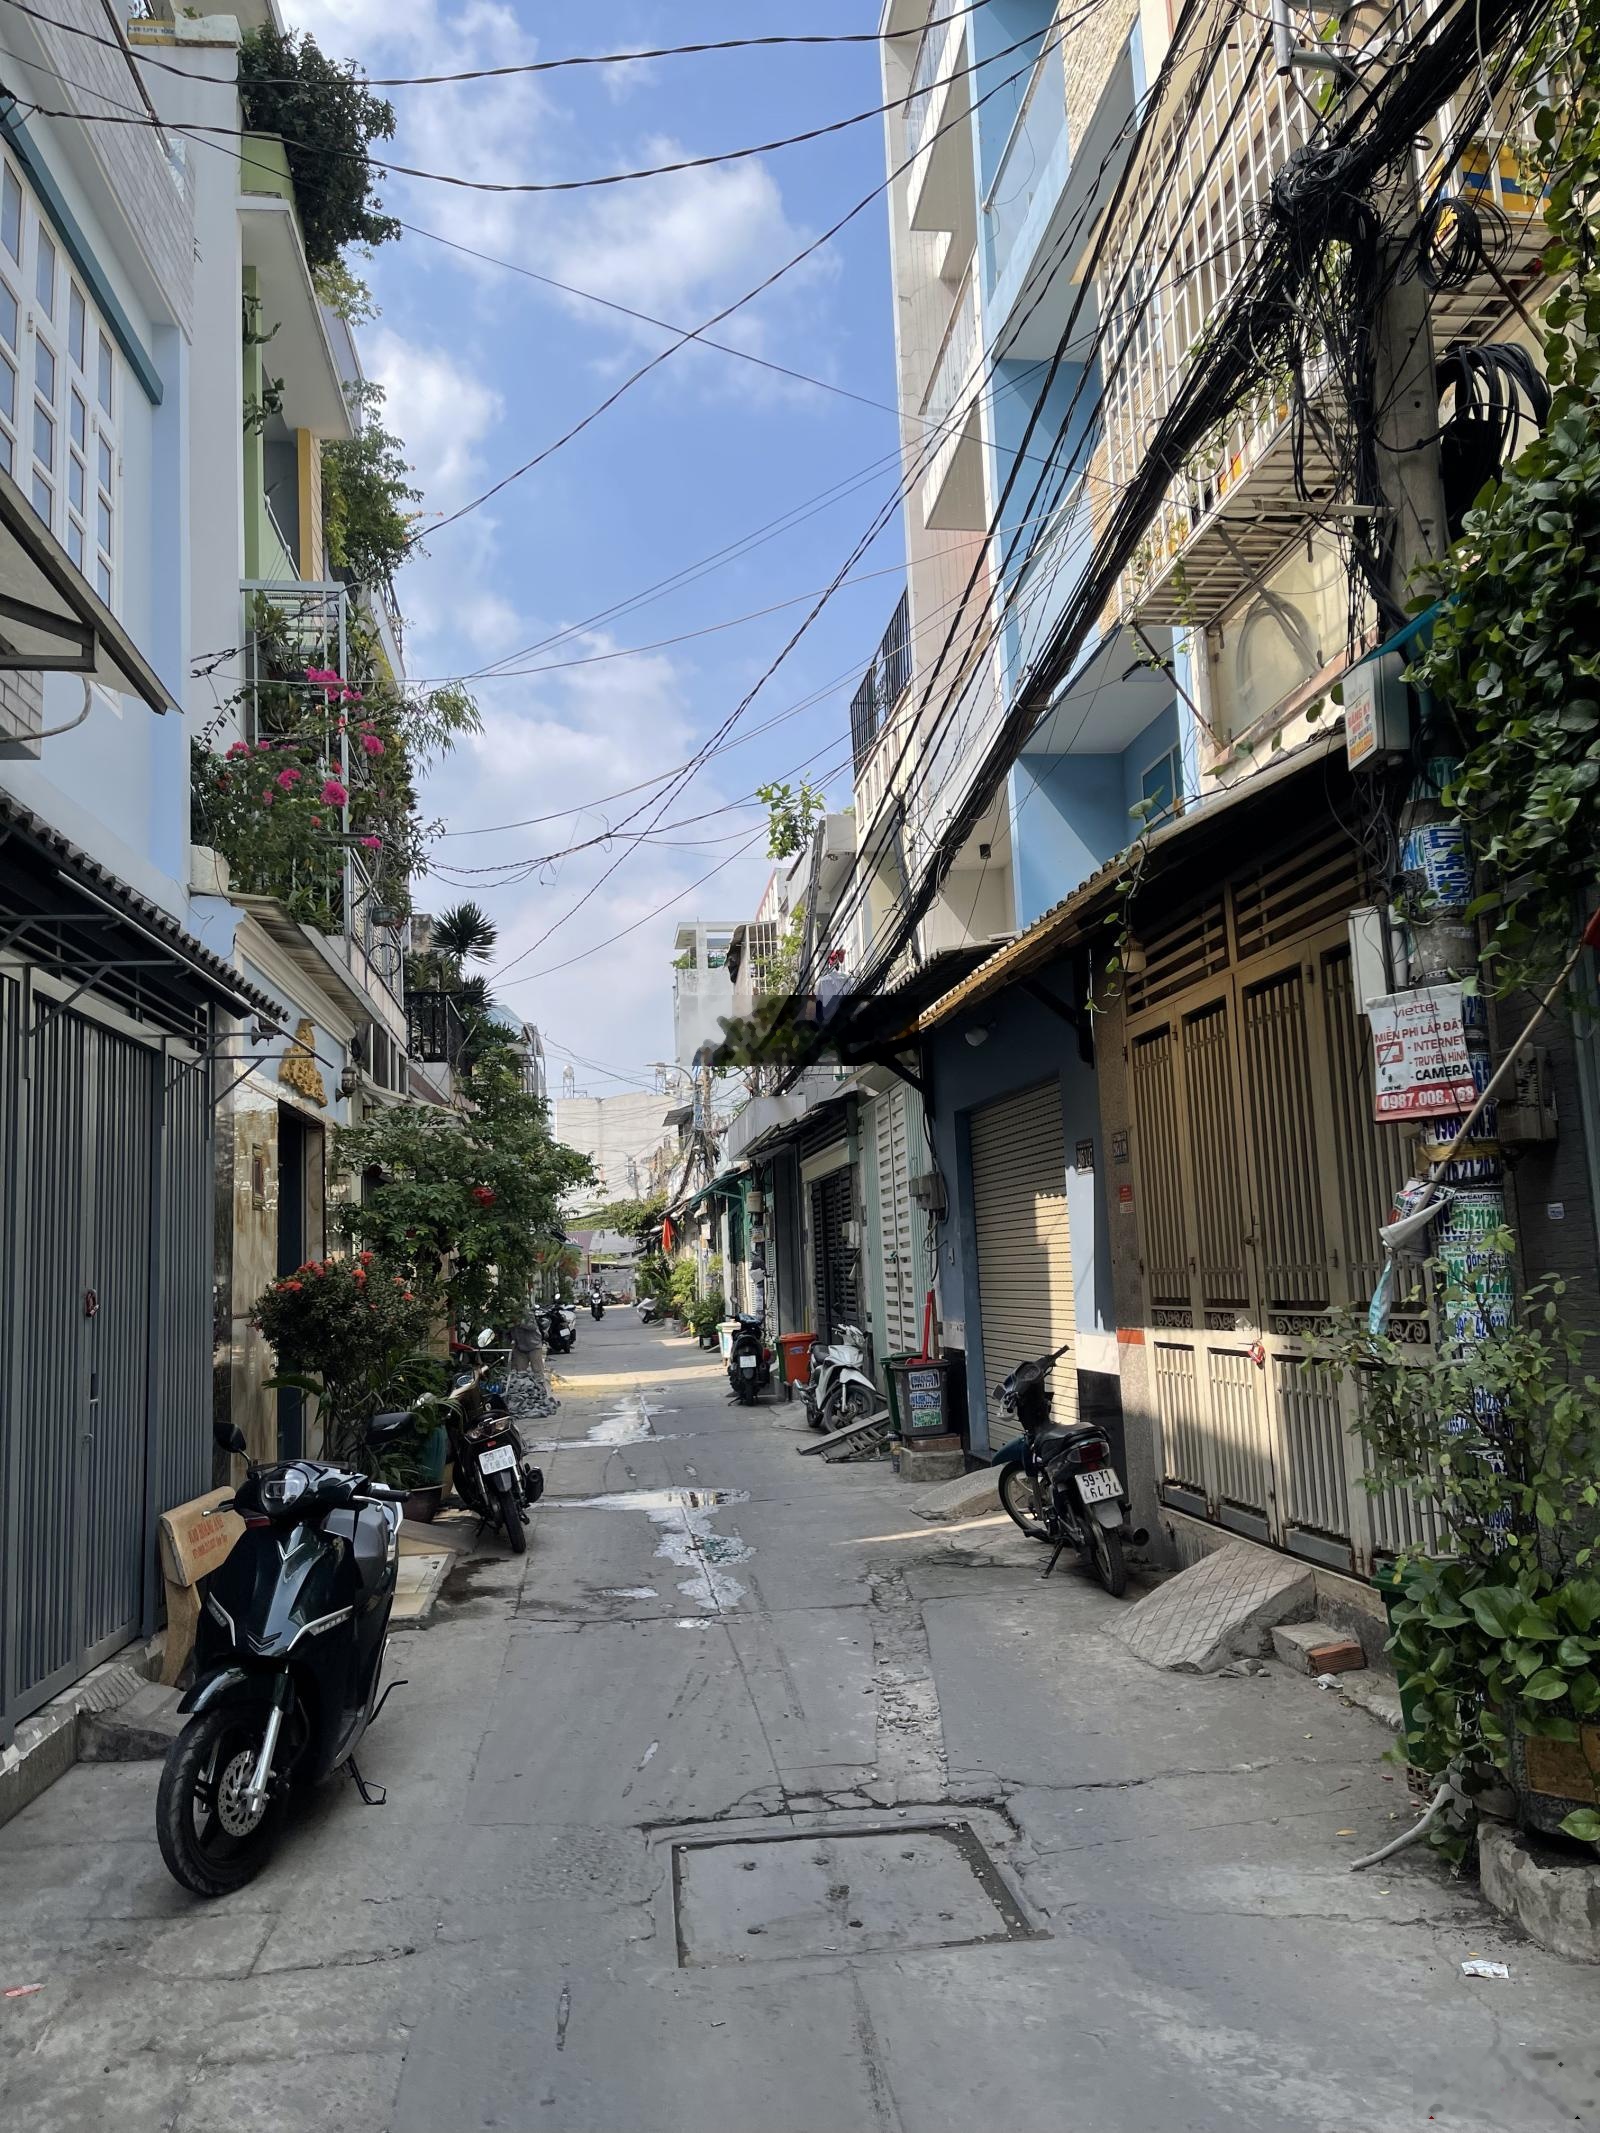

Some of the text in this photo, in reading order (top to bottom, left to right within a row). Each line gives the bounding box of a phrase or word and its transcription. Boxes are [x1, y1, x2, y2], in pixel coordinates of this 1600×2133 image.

[1393, 1000, 1440, 1018] viettel
[1413, 1034, 1465, 1052] INTERNET
[1415, 1064, 1471, 1081] CAMERA
[1380, 1085, 1475, 1110] 0987.008.168
[1081, 1469, 1111, 1488] 59-Y1
